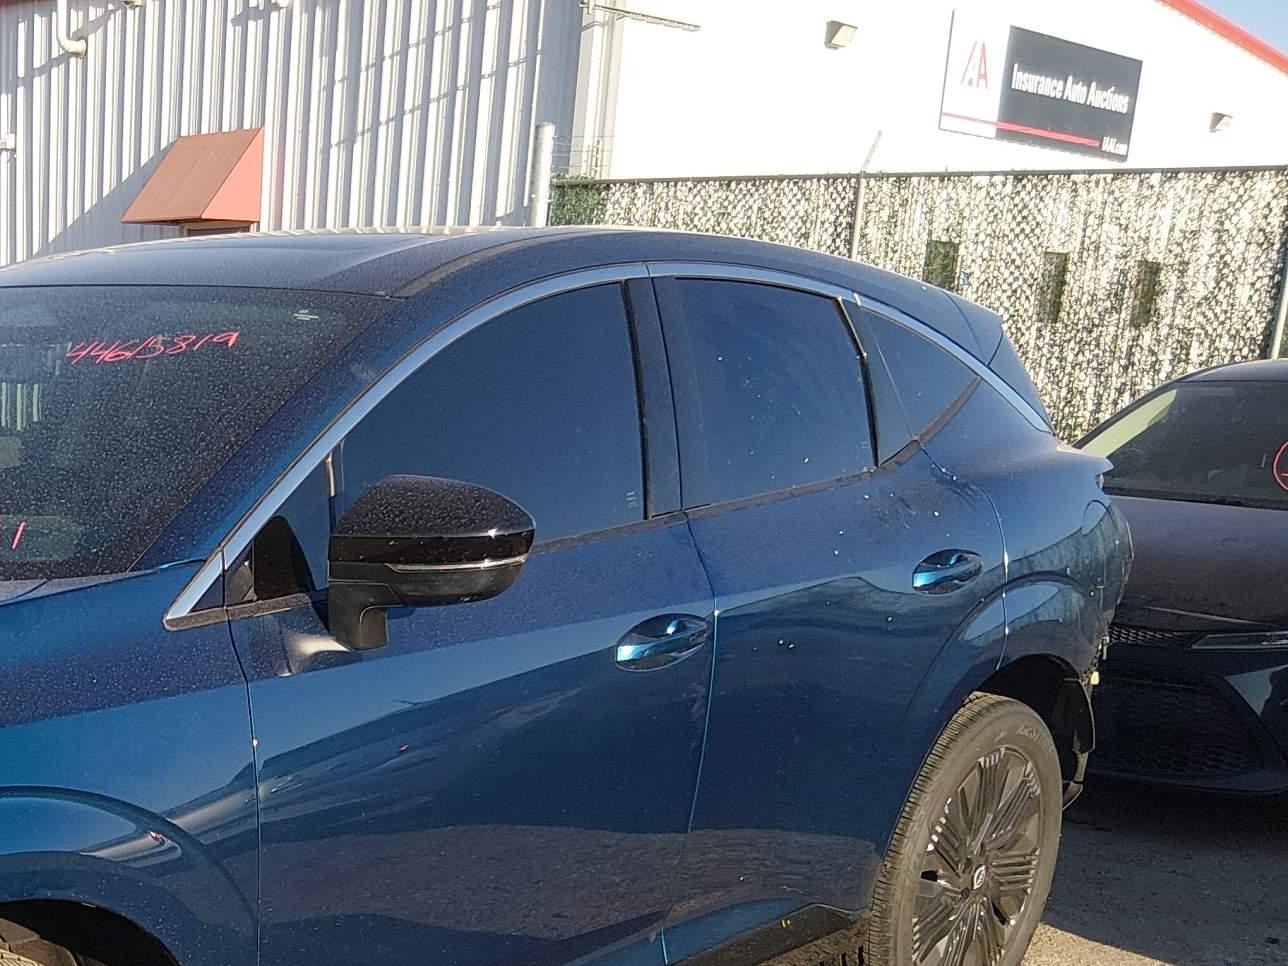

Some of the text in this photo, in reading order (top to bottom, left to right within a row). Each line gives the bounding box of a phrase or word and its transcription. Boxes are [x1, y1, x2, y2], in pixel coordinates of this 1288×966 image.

[1011, 62, 1130, 114] Insurance Auto Auctions
[65, 330, 241, 366] 44615819
